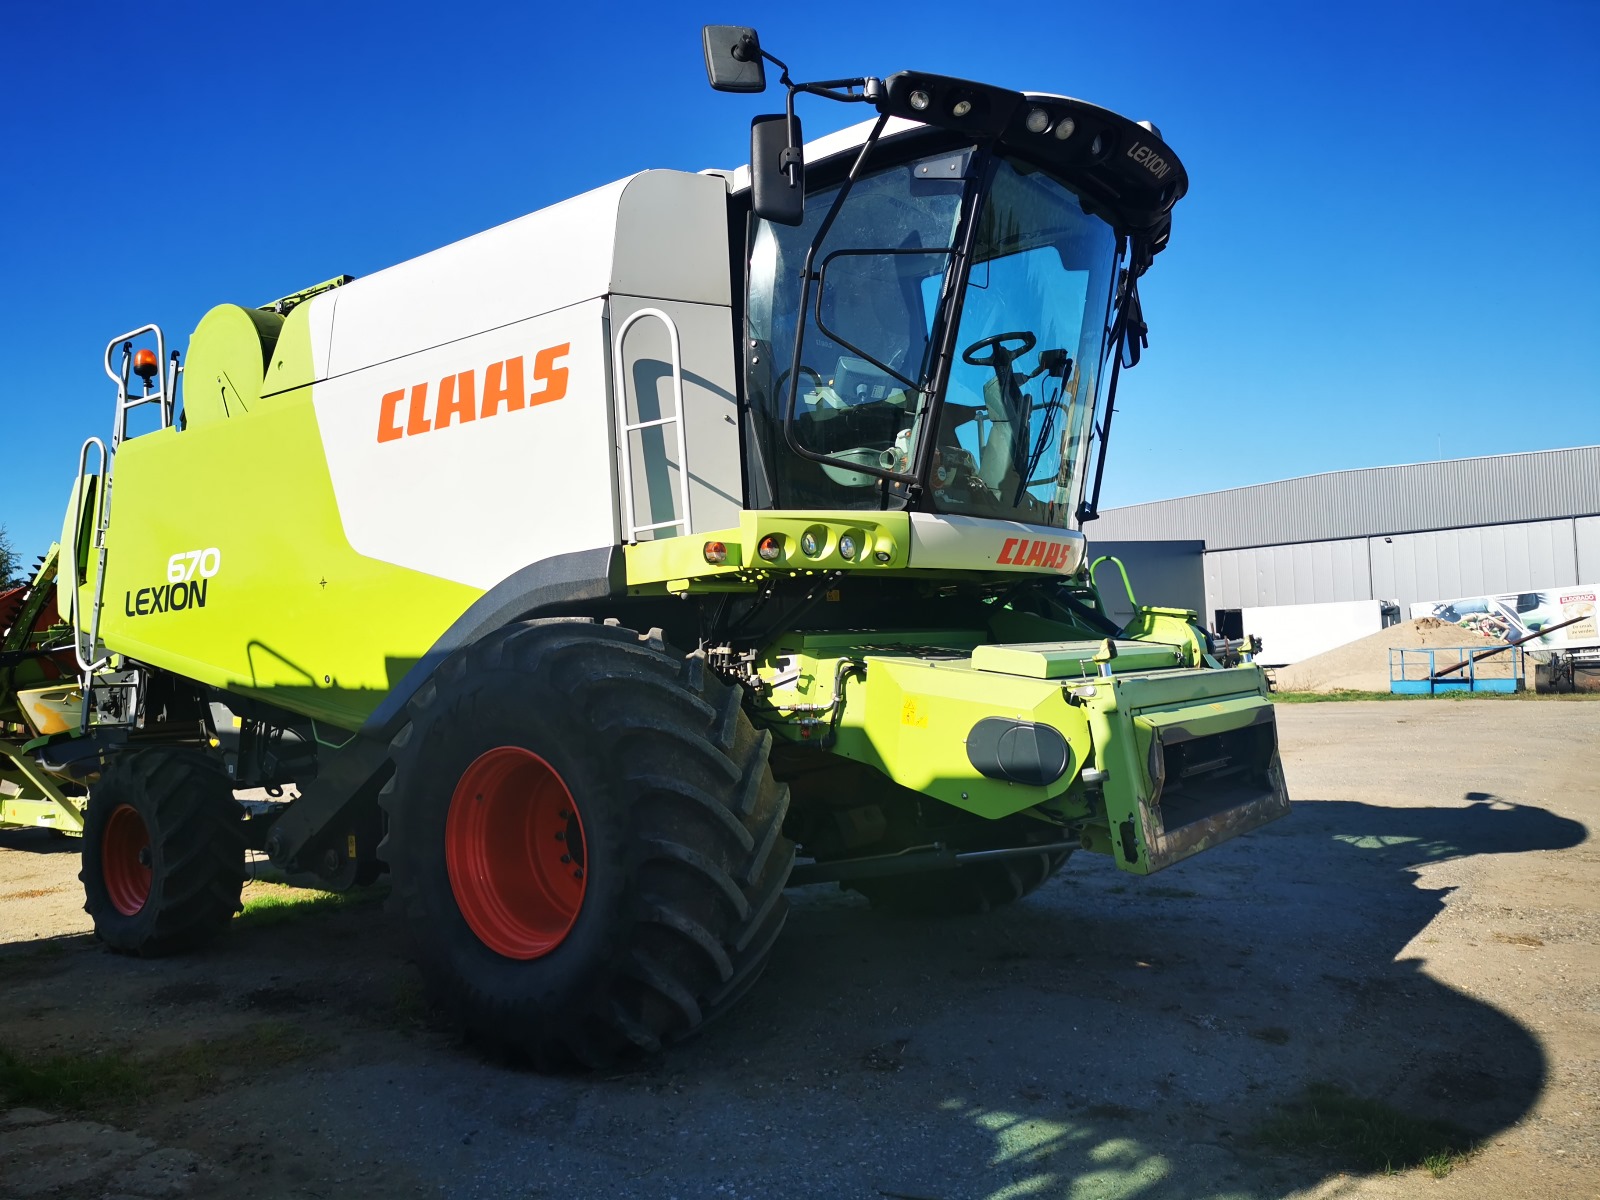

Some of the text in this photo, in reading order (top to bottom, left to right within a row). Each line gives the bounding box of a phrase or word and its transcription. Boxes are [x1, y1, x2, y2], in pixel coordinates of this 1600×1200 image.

[1126, 141, 1171, 179] LEXION
[377, 342, 570, 443] CLAAS
[167, 547, 221, 583] 670
[996, 538, 1071, 569] CLAAS
[125, 579, 208, 617] LEXION
[1561, 594, 1595, 603] ELDORADO
